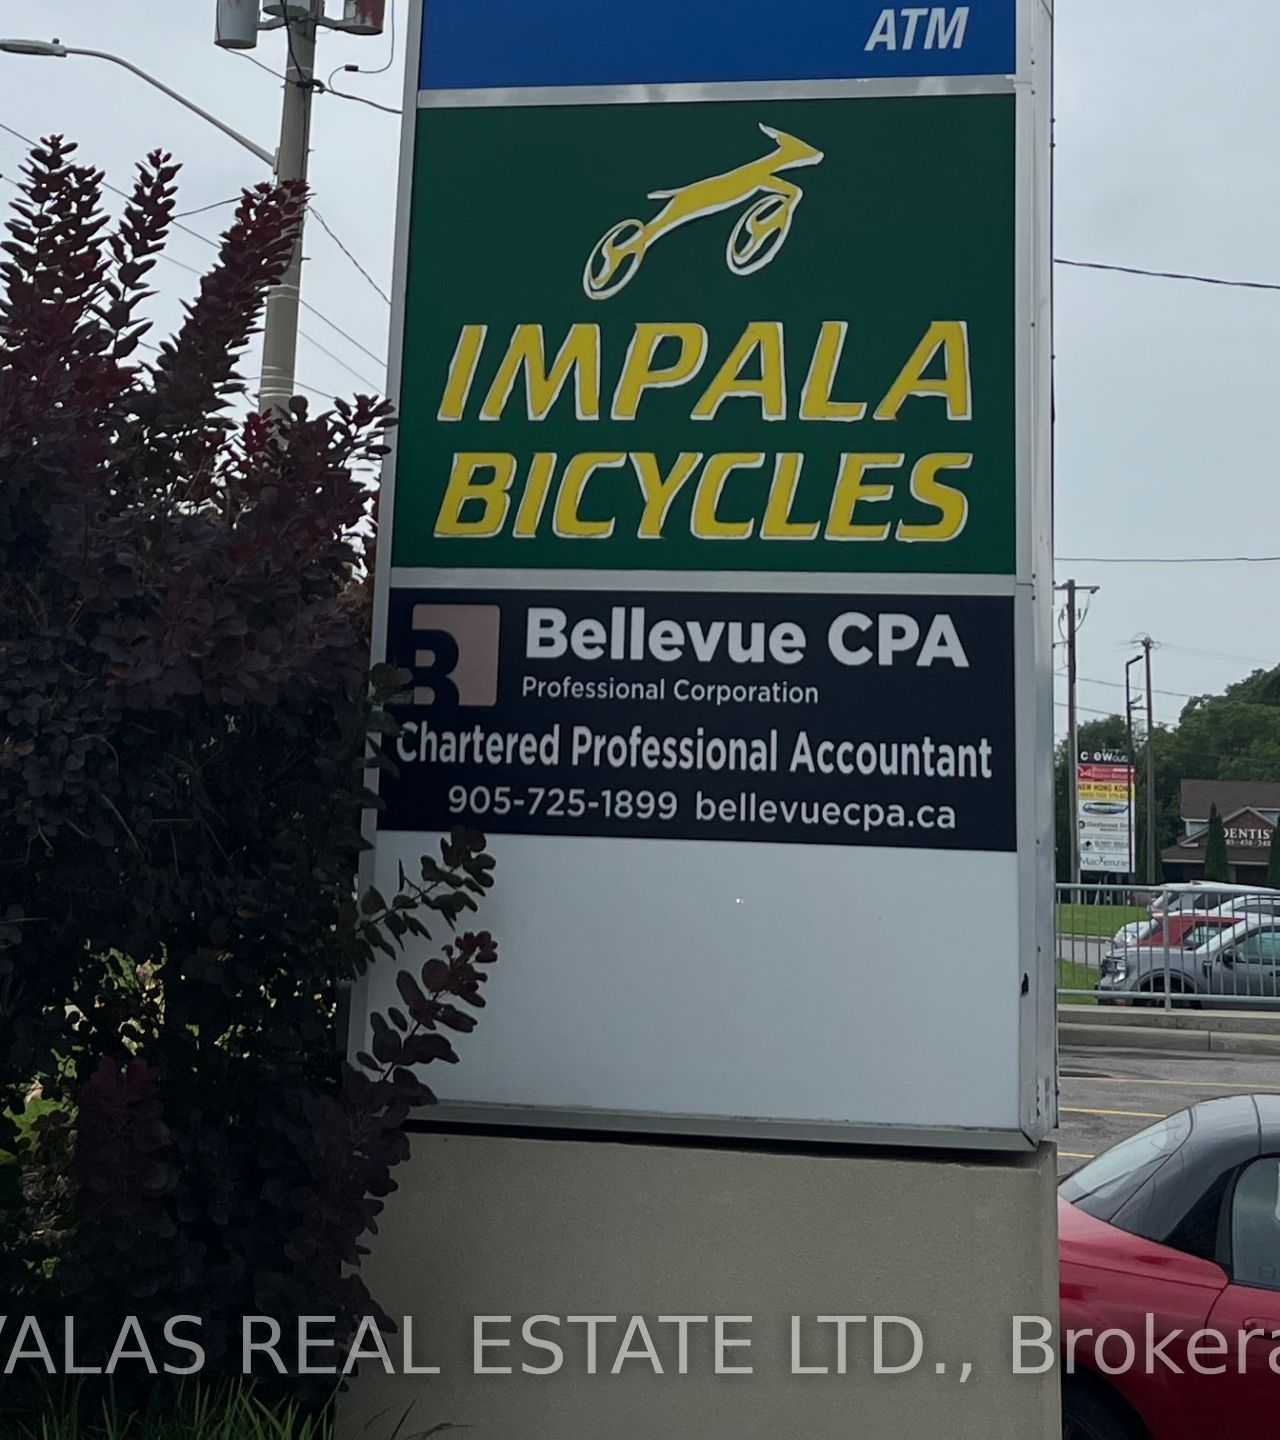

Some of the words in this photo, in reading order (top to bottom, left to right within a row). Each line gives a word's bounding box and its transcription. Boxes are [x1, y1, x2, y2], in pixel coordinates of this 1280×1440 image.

[865, 6, 969, 51] ATM
[435, 320, 973, 423] IMPALA
[432, 451, 974, 543] BICYCLES
[526, 607, 806, 664] Bellevue
[828, 612, 969, 667] CPA
[522, 676, 665, 701] Professional
[673, 678, 819, 706] Corporation
[396, 721, 560, 765] Chartered
[572, 726, 778, 772] Professional
[789, 731, 992, 778] Accountant
[448, 785, 678, 820] 905-725-1899
[696, 790, 957, 832] bellevuecpa.ca
[1223, 827, 1273, 840] DENTIS
